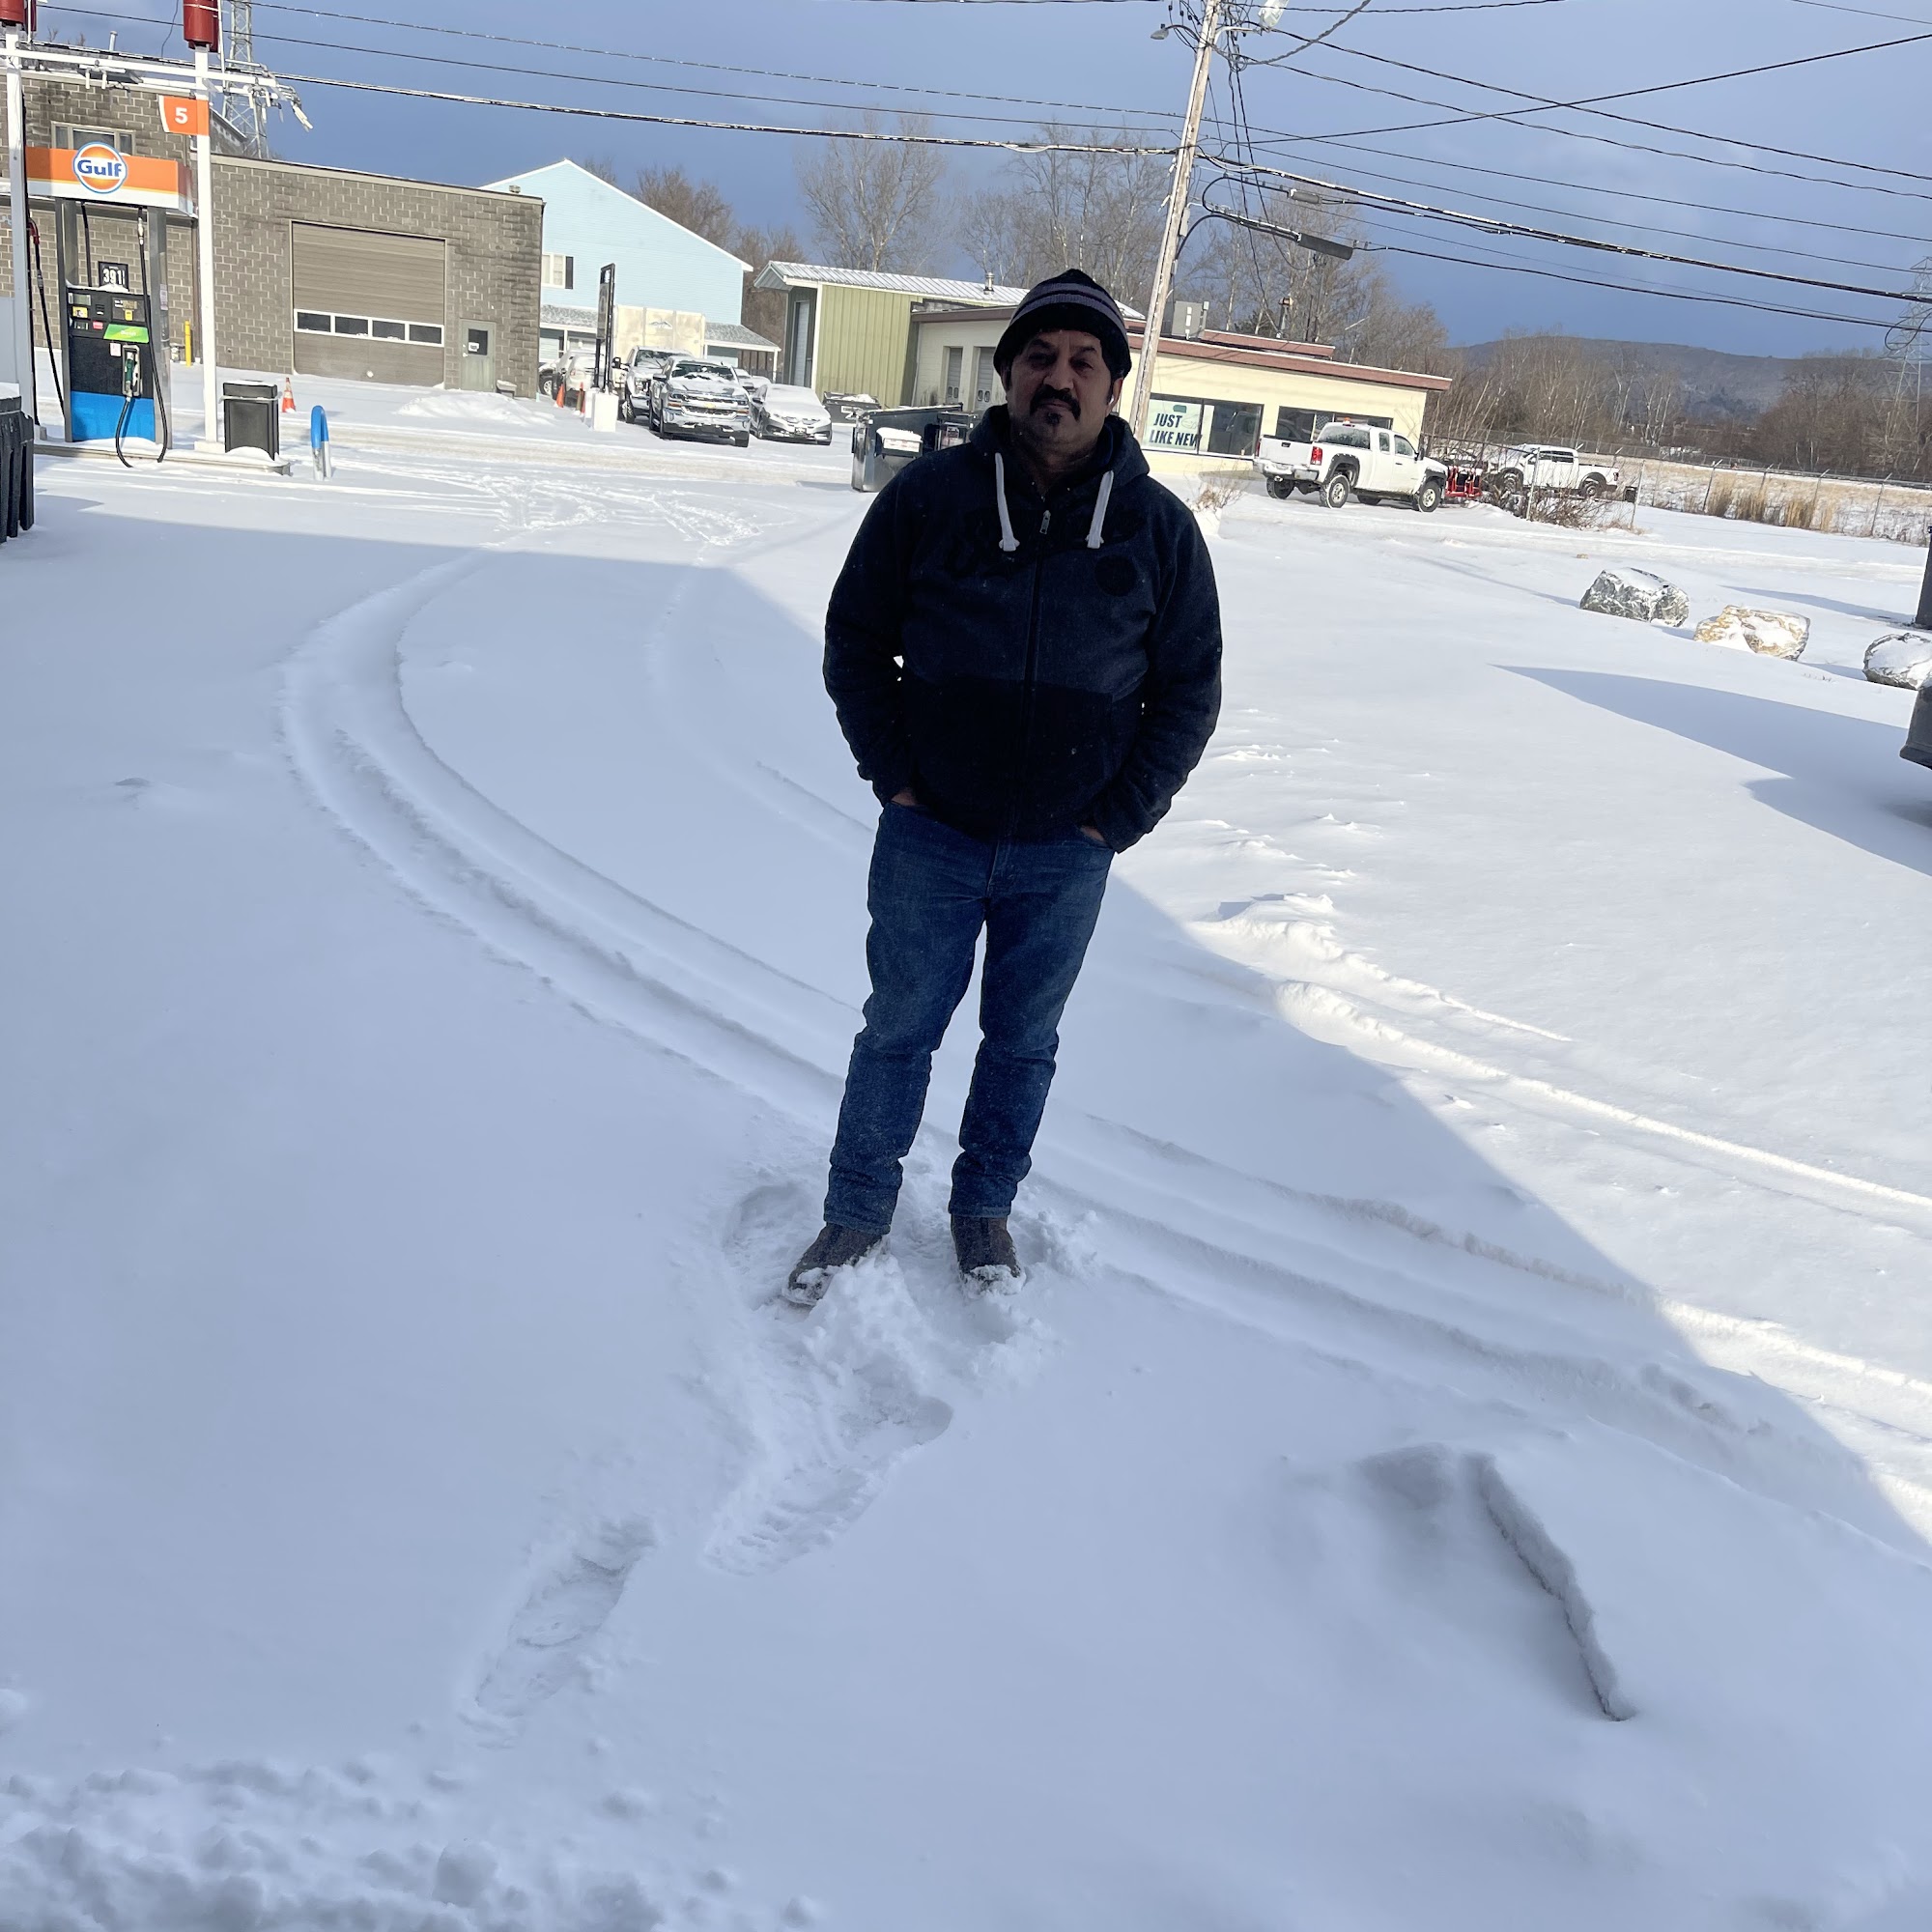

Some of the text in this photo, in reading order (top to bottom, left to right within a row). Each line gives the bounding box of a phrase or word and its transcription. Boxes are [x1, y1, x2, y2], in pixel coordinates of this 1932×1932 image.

[175, 107, 188, 124] 5
[77, 159, 122, 177] Gulf
[1153, 413, 1182, 428] JUST
[1149, 430, 1174, 444] LIKE
